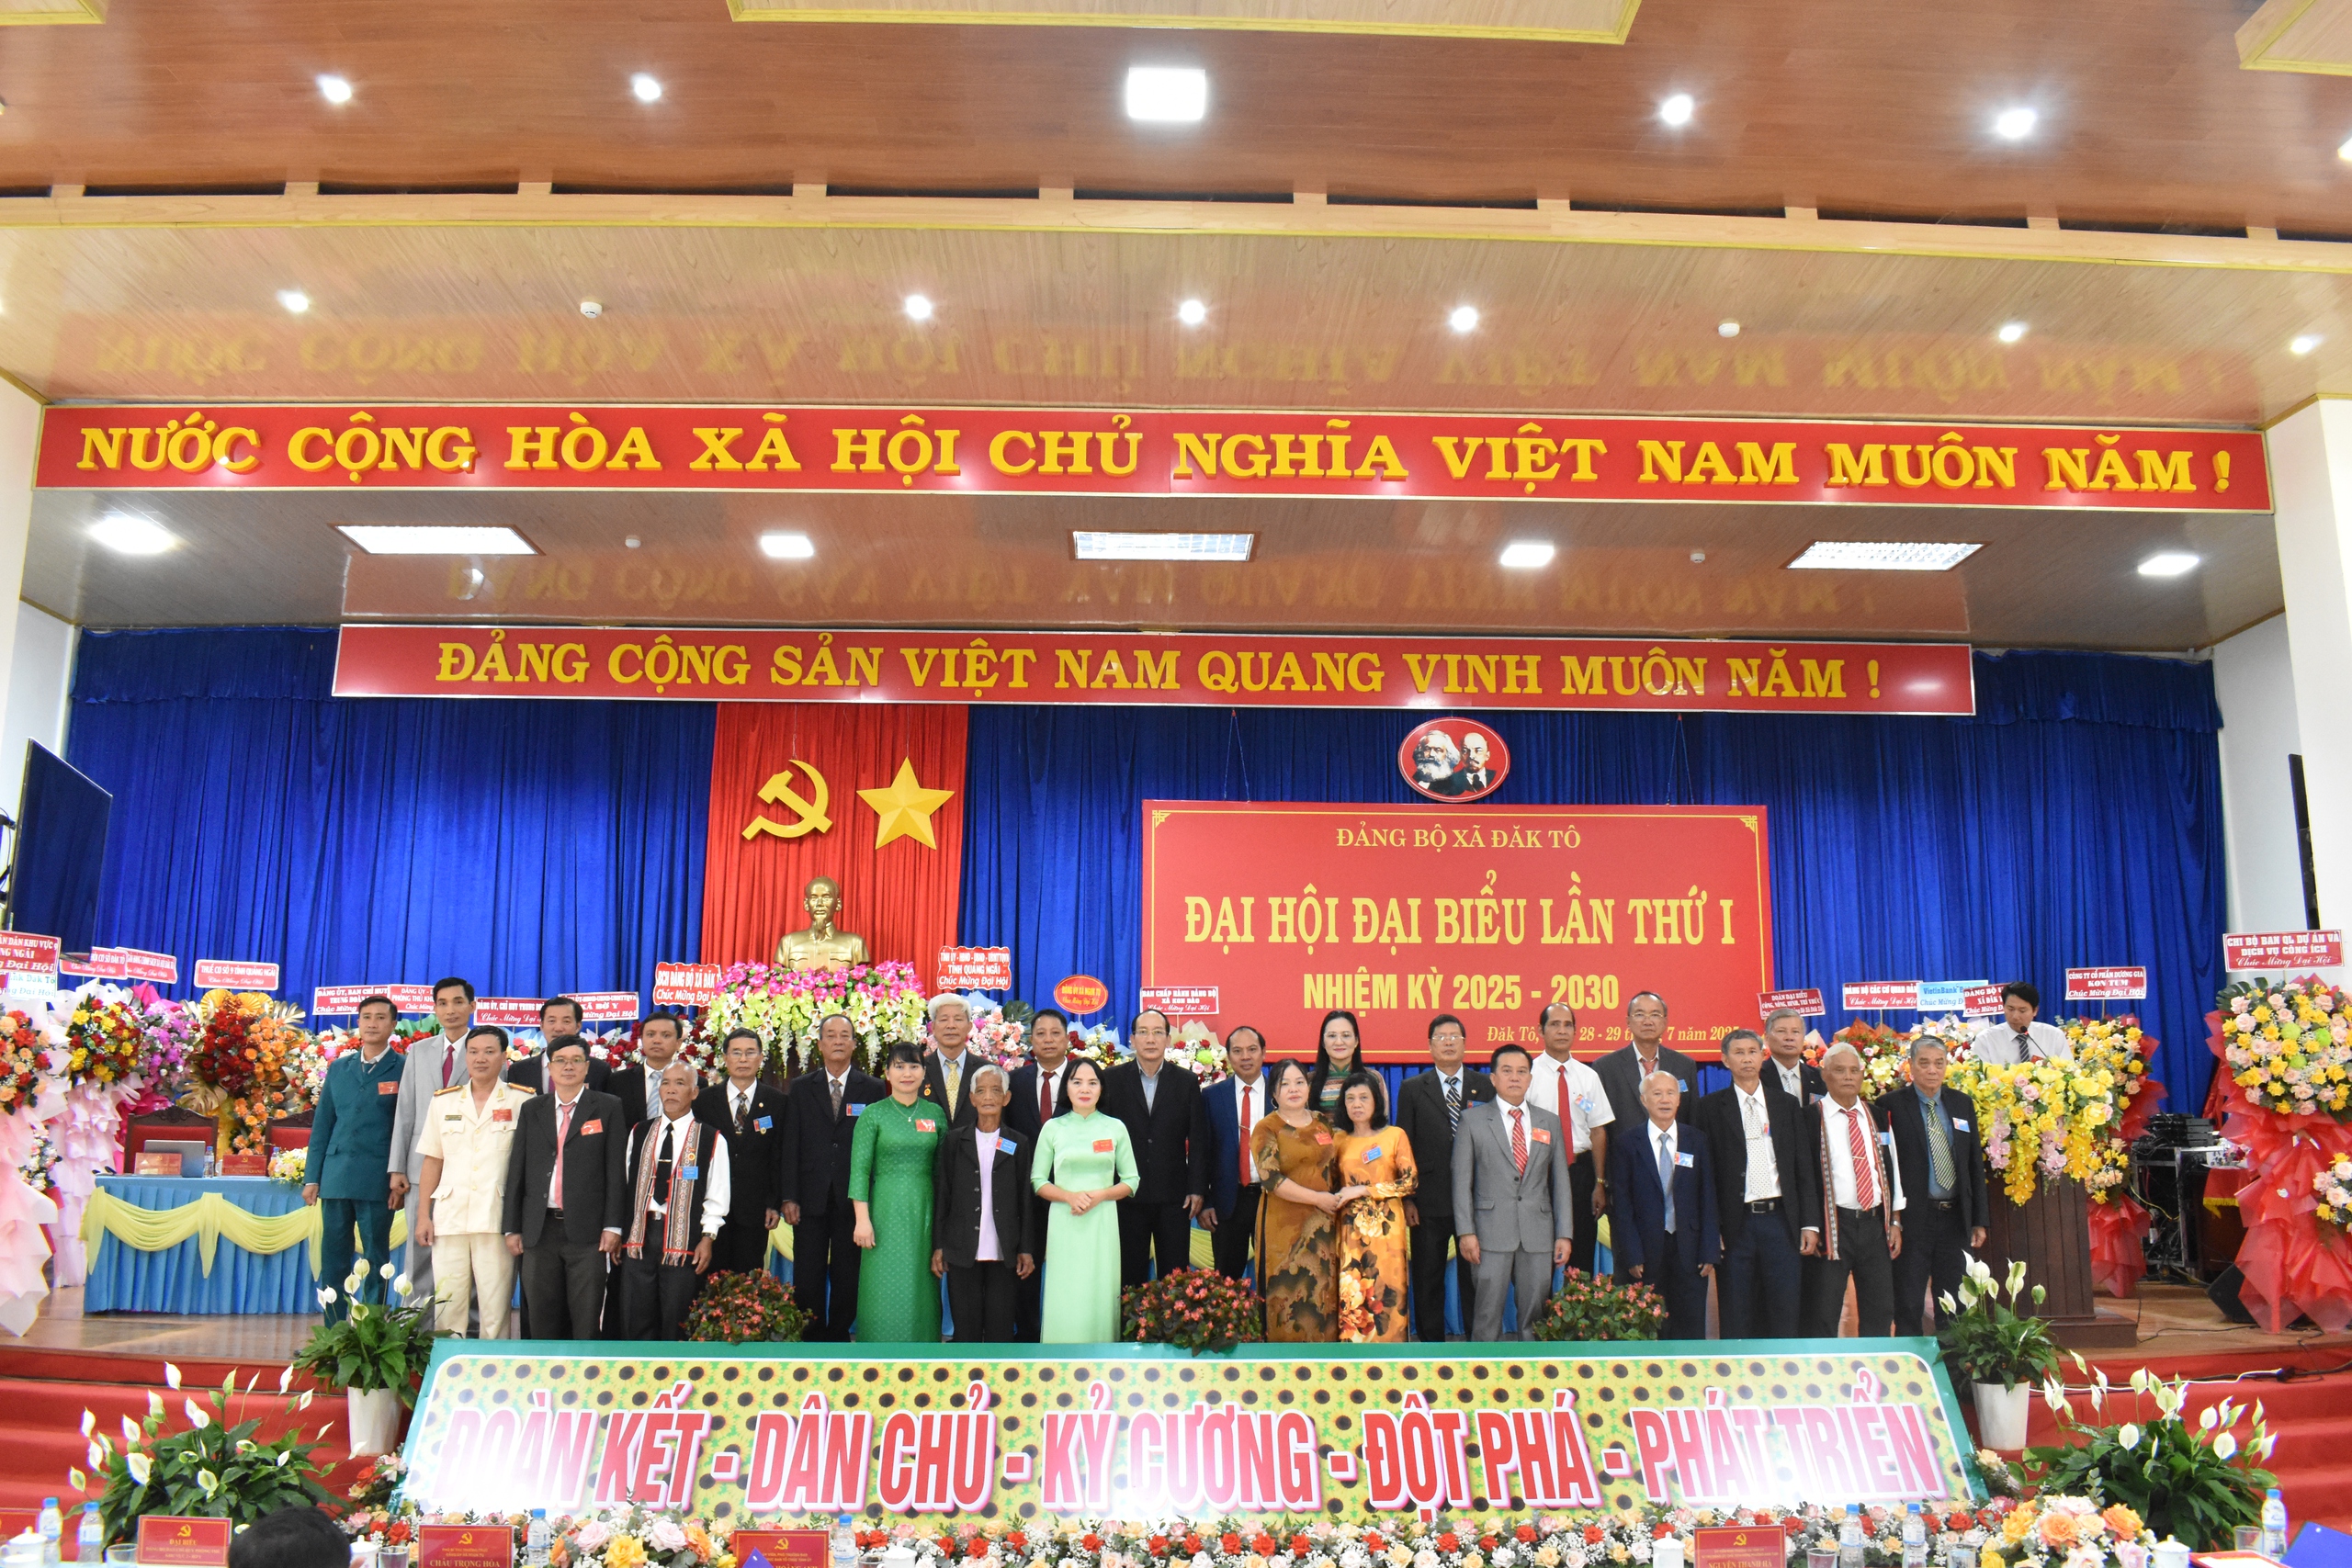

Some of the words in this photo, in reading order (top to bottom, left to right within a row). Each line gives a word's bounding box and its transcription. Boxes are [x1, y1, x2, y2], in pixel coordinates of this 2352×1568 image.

[76, 412, 259, 470] NƯỚC
[288, 412, 478, 482] CỘNG
[504, 412, 662, 470] HÒA
[689, 412, 802, 470] XÃ
[831, 414, 961, 486] HỘI
[989, 414, 1143, 476] CHỦ
[1173, 419, 1408, 480] NGHĨA
[1432, 422, 1608, 493] VIỆT
[1637, 439, 1800, 485] NAM
[1824, 431, 2018, 489] MUÔN
[2042, 434, 2197, 493] NĂM
[2212, 450, 2231, 493] !
[435, 629, 591, 683] ĐẢNG
[608, 634, 752, 694] CỘNG
[770, 633, 885, 688] SẢN
[900, 638, 1038, 698] VIỆT
[1055, 649, 1182, 691] NAM
[1198, 650, 1385, 694] QUANG
[1402, 654, 1544, 695] VINH
[1560, 648, 1708, 697] MUÔN
[1726, 649, 1847, 699] NĂM
[1868, 660, 1881, 699] !
[1336, 820, 1407, 849] ĐẢNG
[1413, 827, 1447, 853] BỘ
[1452, 827, 1486, 849] XÃ
[1491, 826, 1543, 850] ĐĂK
[1548, 826, 1582, 849] TÔ
[1184, 895, 1254, 954] ĐẠI
[1268, 883, 1338, 954] HỘI
[1353, 896, 1422, 955] ĐẠI
[1435, 869, 1527, 946] BIỂU
[1541, 871, 1615, 946] LẦN
[1627, 885, 1709, 946] THỨ
[1721, 898, 1736, 946] I
[2227, 938, 2243, 946] CHI
[2245, 935, 2258, 945] BỘ
[2261, 936, 2279, 944] BAN
[2282, 935, 2294, 944] QL
[2241, 948, 2264, 957] DỊCH
[2282, 945, 2308, 954] CÔNG
[656, 989, 673, 1000] Chúc
[939, 976, 957, 985] Chúc
[959, 976, 979, 987] Mừng
[996, 976, 1008, 987] Hội
[1303, 966, 1398, 1017] NHIỆM
[1408, 966, 1443, 1010] KỲ
[1453, 975, 1523, 1010] 2025
[1532, 991, 1543, 999] -
[1551, 975, 1621, 1010] 2030
[1487, 1026, 1515, 1042] Đăk
[1519, 1026, 1540, 1043] Tô,
[1579, 1026, 1594, 1041] 28
[1606, 1026, 1621, 1041] 29
[1667, 1026, 1675, 1041] 7
[1678, 1026, 1707, 1042] năm
[1709, 1025, 1740, 1041] 202
[437, 1391, 594, 1506] ĐOÀN
[594, 1382, 707, 1504] KẾT
[746, 1393, 866, 1504] DÂN
[879, 1382, 994, 1504] CHỦ
[1042, 1382, 1119, 1504] KỶ
[1129, 1402, 1313, 1504] CƯƠNG
[1364, 1393, 1465, 1524] ĐỘT
[1480, 1392, 1583, 1502] PHÁ
[1632, 1388, 1768, 1500] PHÁT
[1777, 1370, 1942, 1498] TRIỂN
